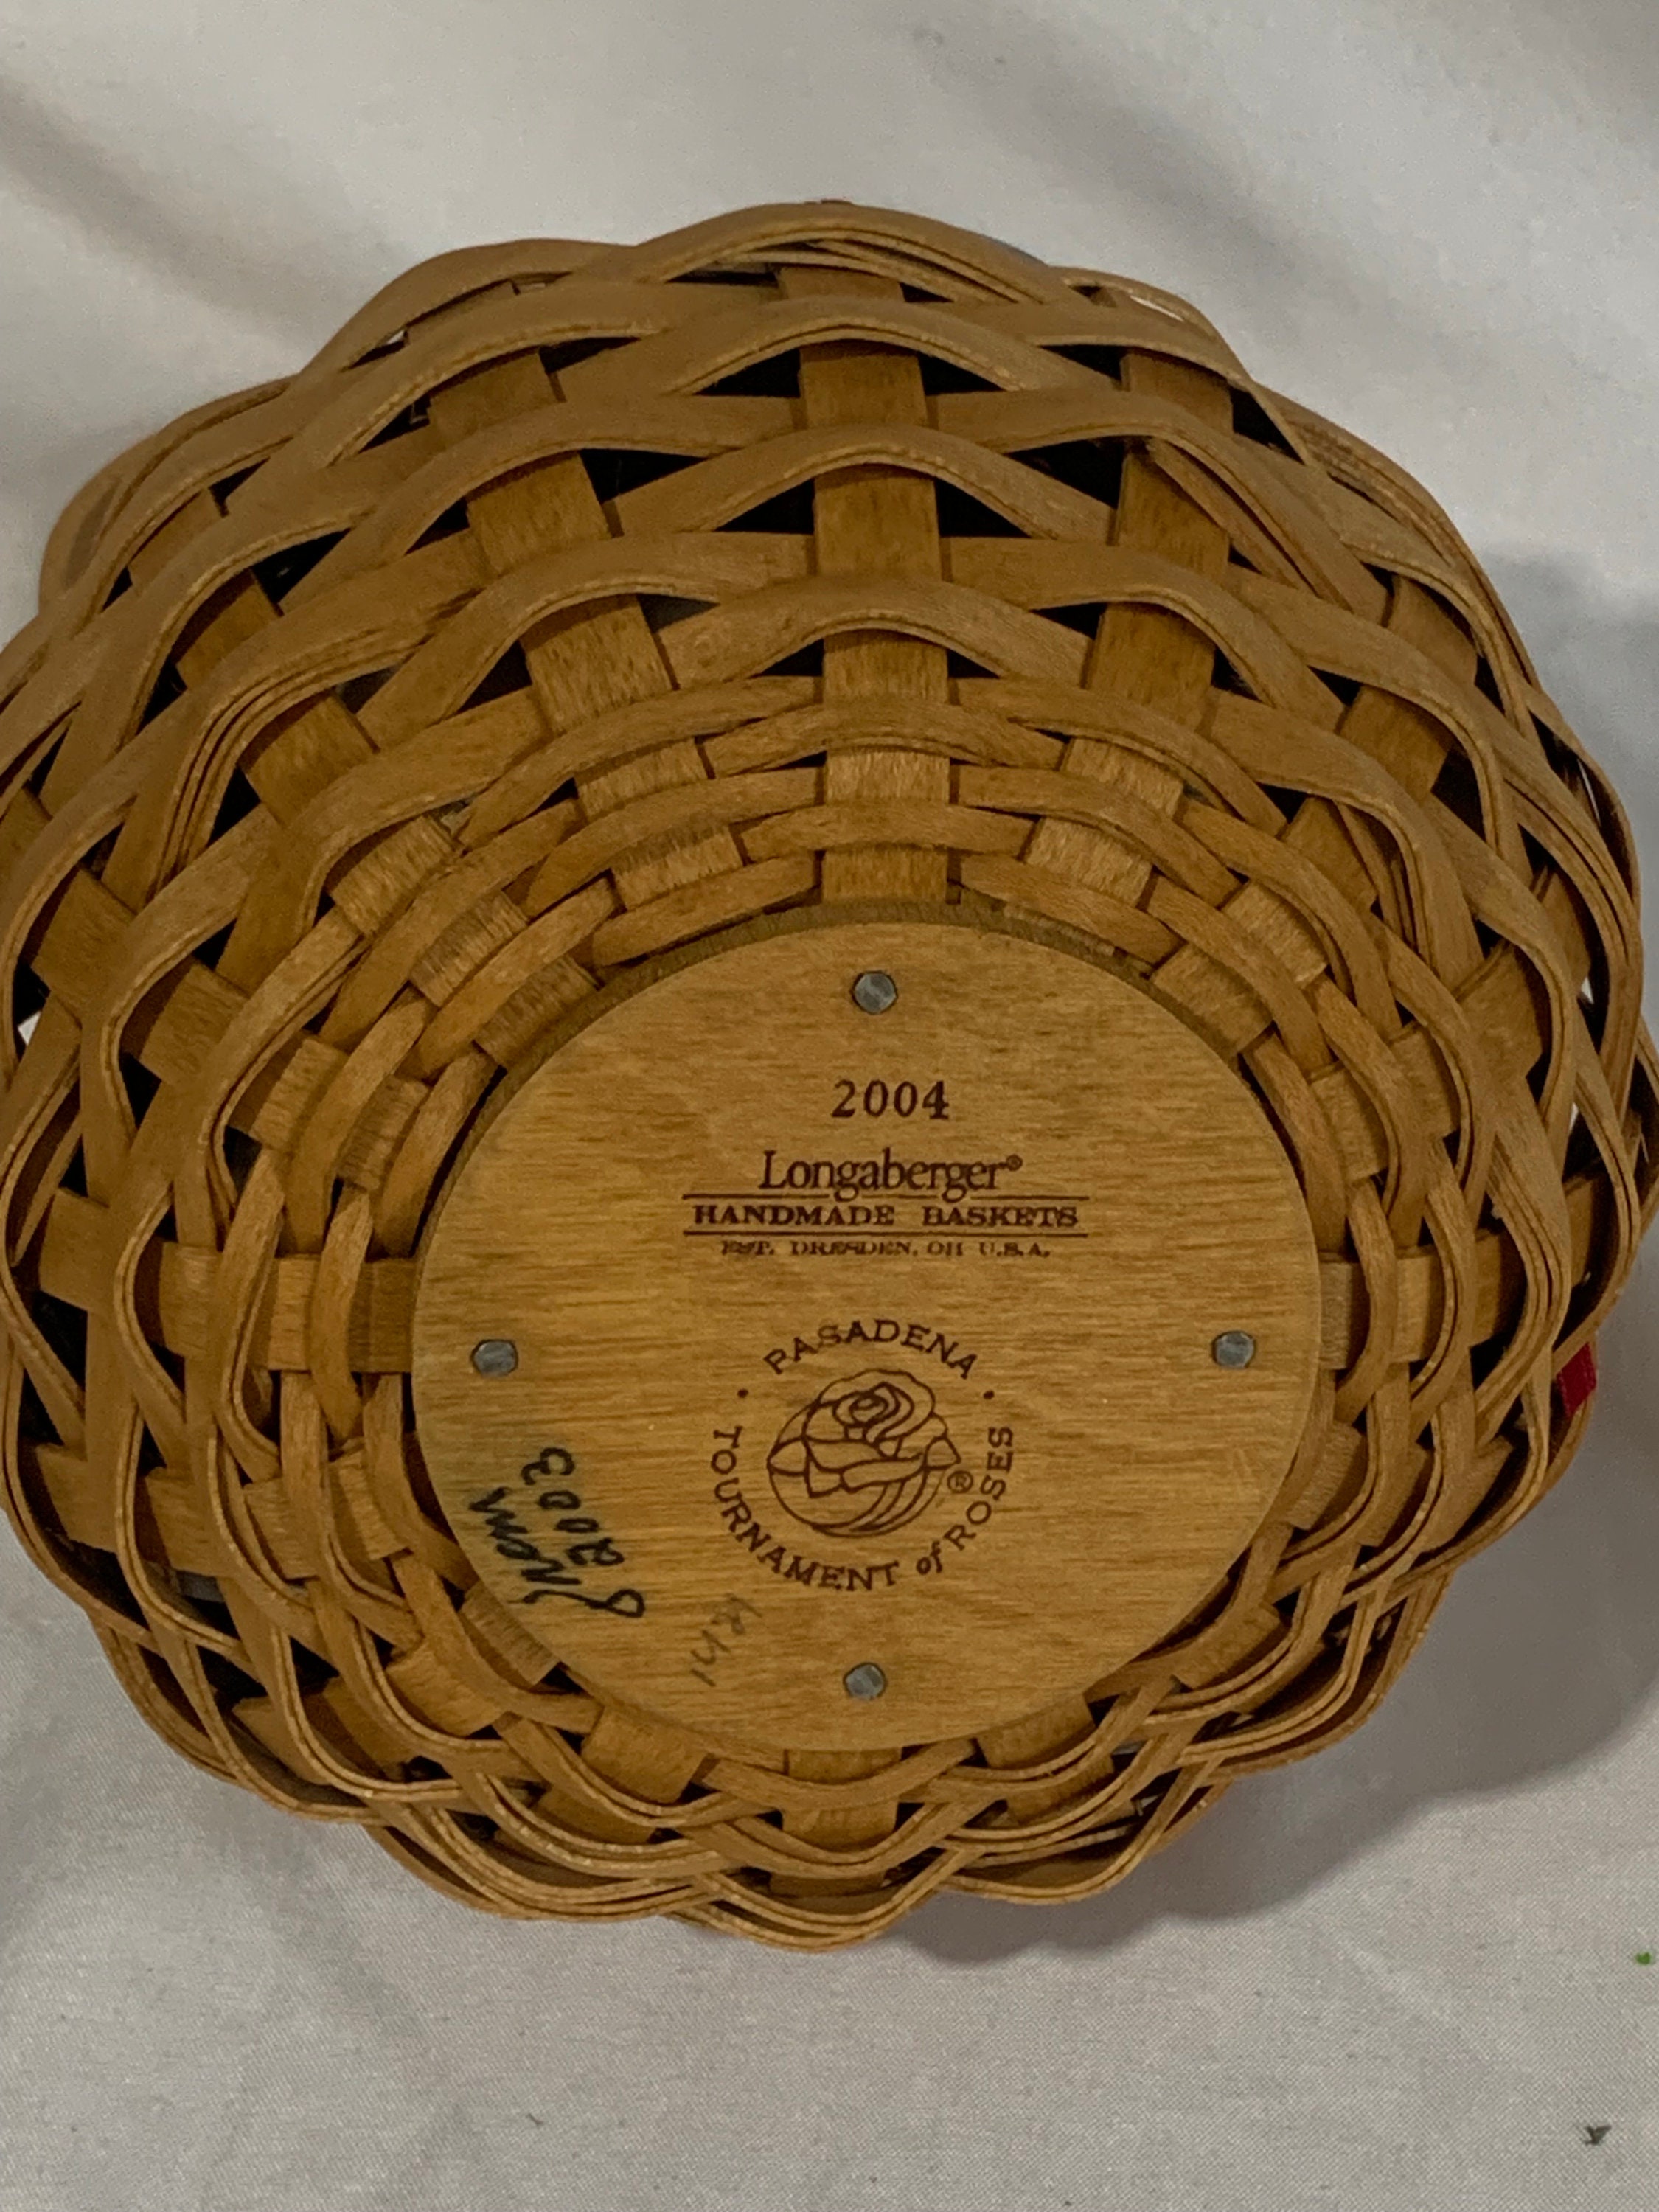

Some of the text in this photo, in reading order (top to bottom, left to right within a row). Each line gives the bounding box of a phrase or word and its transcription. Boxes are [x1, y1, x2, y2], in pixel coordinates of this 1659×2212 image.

[831, 1079, 950, 1120] 2004
[693, 1204, 1079, 1227] HANDMADE BASKETS
[927, 1241, 962, 1256] OH
[979, 1241, 1051, 1258] U.S.A.
[763, 1319, 978, 1379] PASADENA
[710, 1425, 1015, 1592] TOURNAMENT of ROSES
